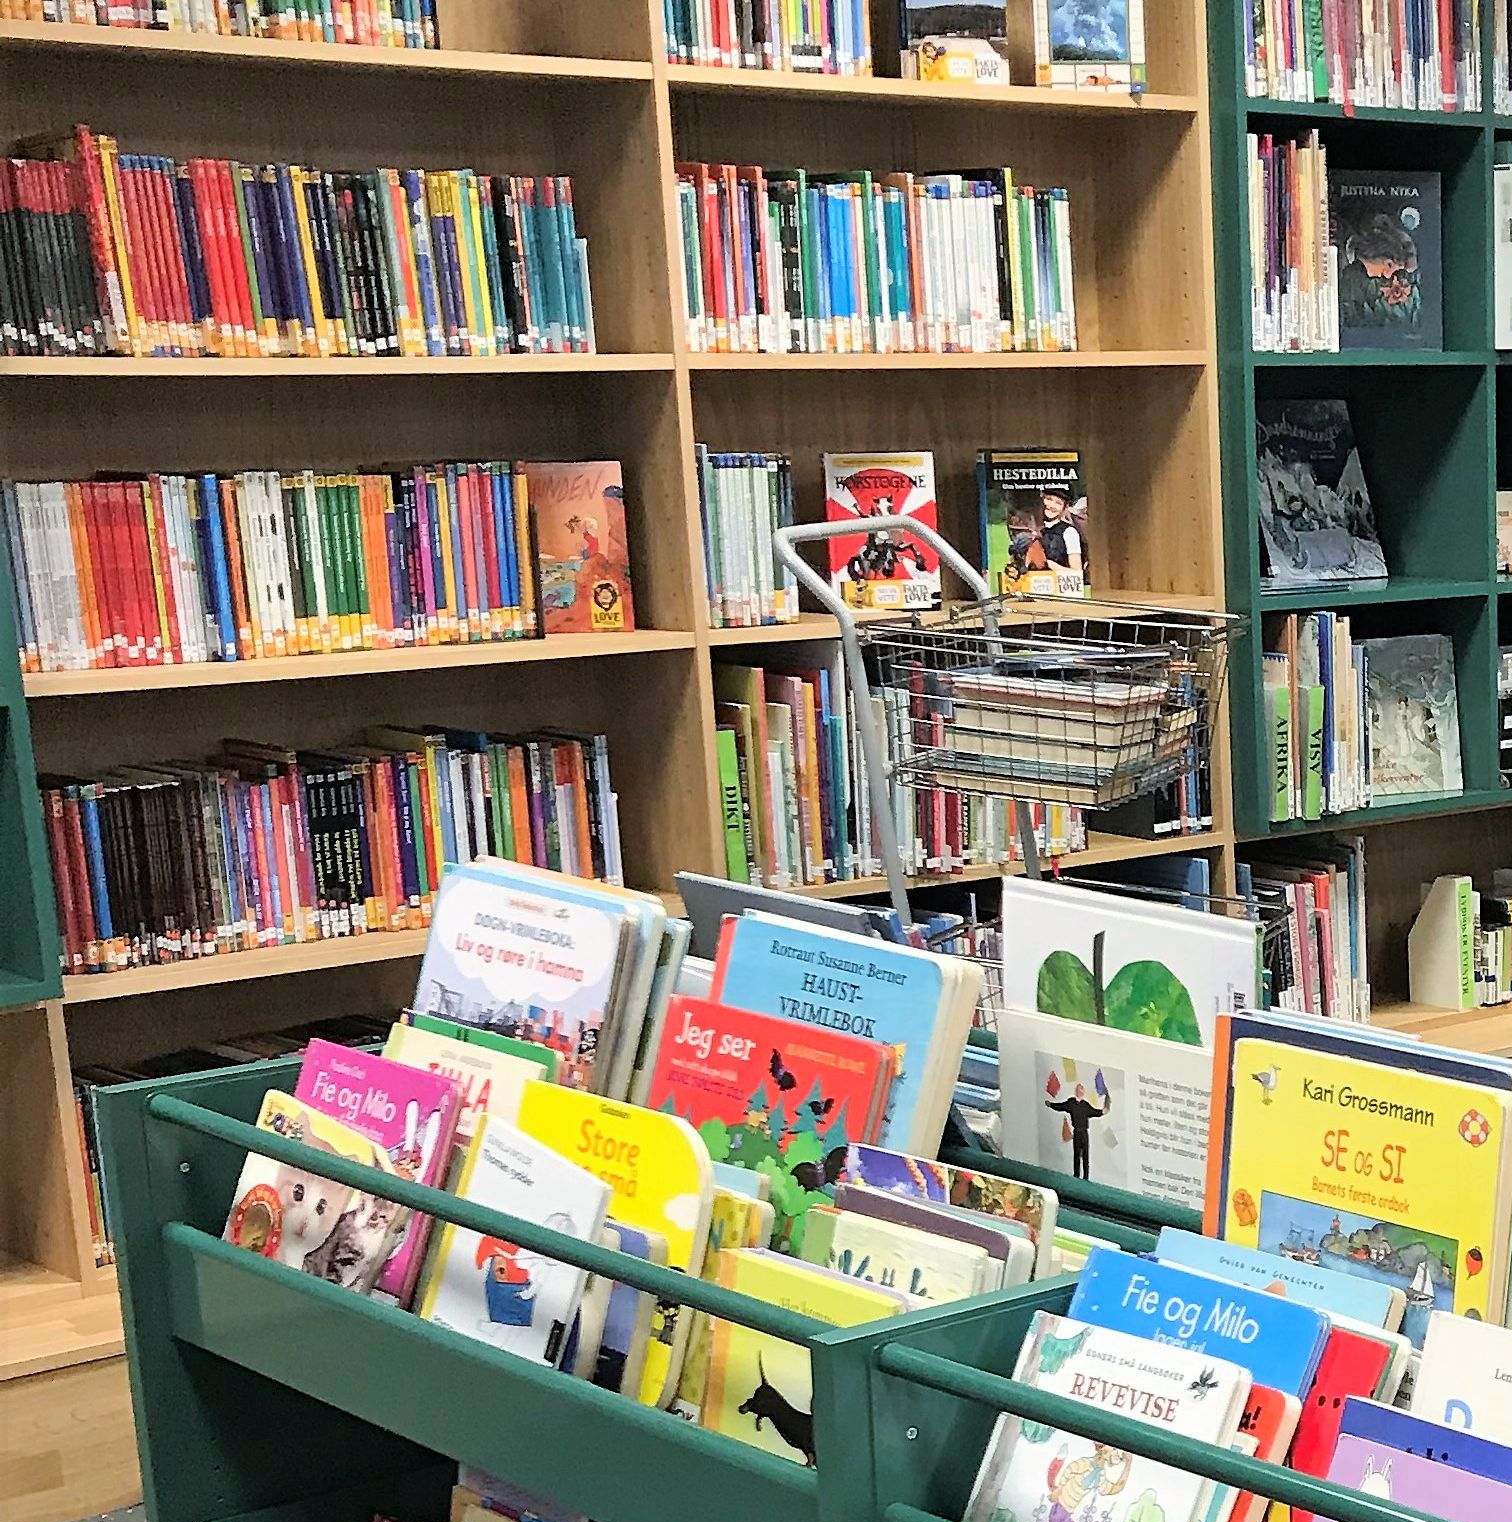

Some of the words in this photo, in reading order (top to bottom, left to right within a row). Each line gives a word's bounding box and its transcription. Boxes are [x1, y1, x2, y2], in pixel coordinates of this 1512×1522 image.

[993, 468, 1078, 481] HESTEDILLA
[1275, 716, 1289, 794] AFRIKA
[725, 785, 740, 833] DIKT
[455, 932, 475, 952] Liv
[477, 942, 493, 963] og
[818, 951, 865, 976] Susanne
[866, 963, 907, 986] Berner
[801, 972, 863, 1003] HAUST-
[674, 1011, 715, 1060] Jeg
[716, 1031, 757, 1061] ser
[779, 996, 877, 1039] VRIMLEBOK
[311, 1071, 337, 1102] Fie
[337, 1085, 360, 1120] og
[1302, 1077, 1335, 1104] Kari
[1338, 1086, 1435, 1128] Grossmann
[576, 1118, 641, 1168] Store
[1320, 1128, 1350, 1172] SE
[1353, 1151, 1373, 1178] OG
[1379, 1142, 1407, 1185] SI
[1311, 1176, 1346, 1198] Barnets
[1121, 1273, 1160, 1316] Fie
[1163, 1297, 1203, 1340] og
[1203, 1298, 1260, 1345] Milo
[1068, 1372, 1180, 1423] REVEVISE
